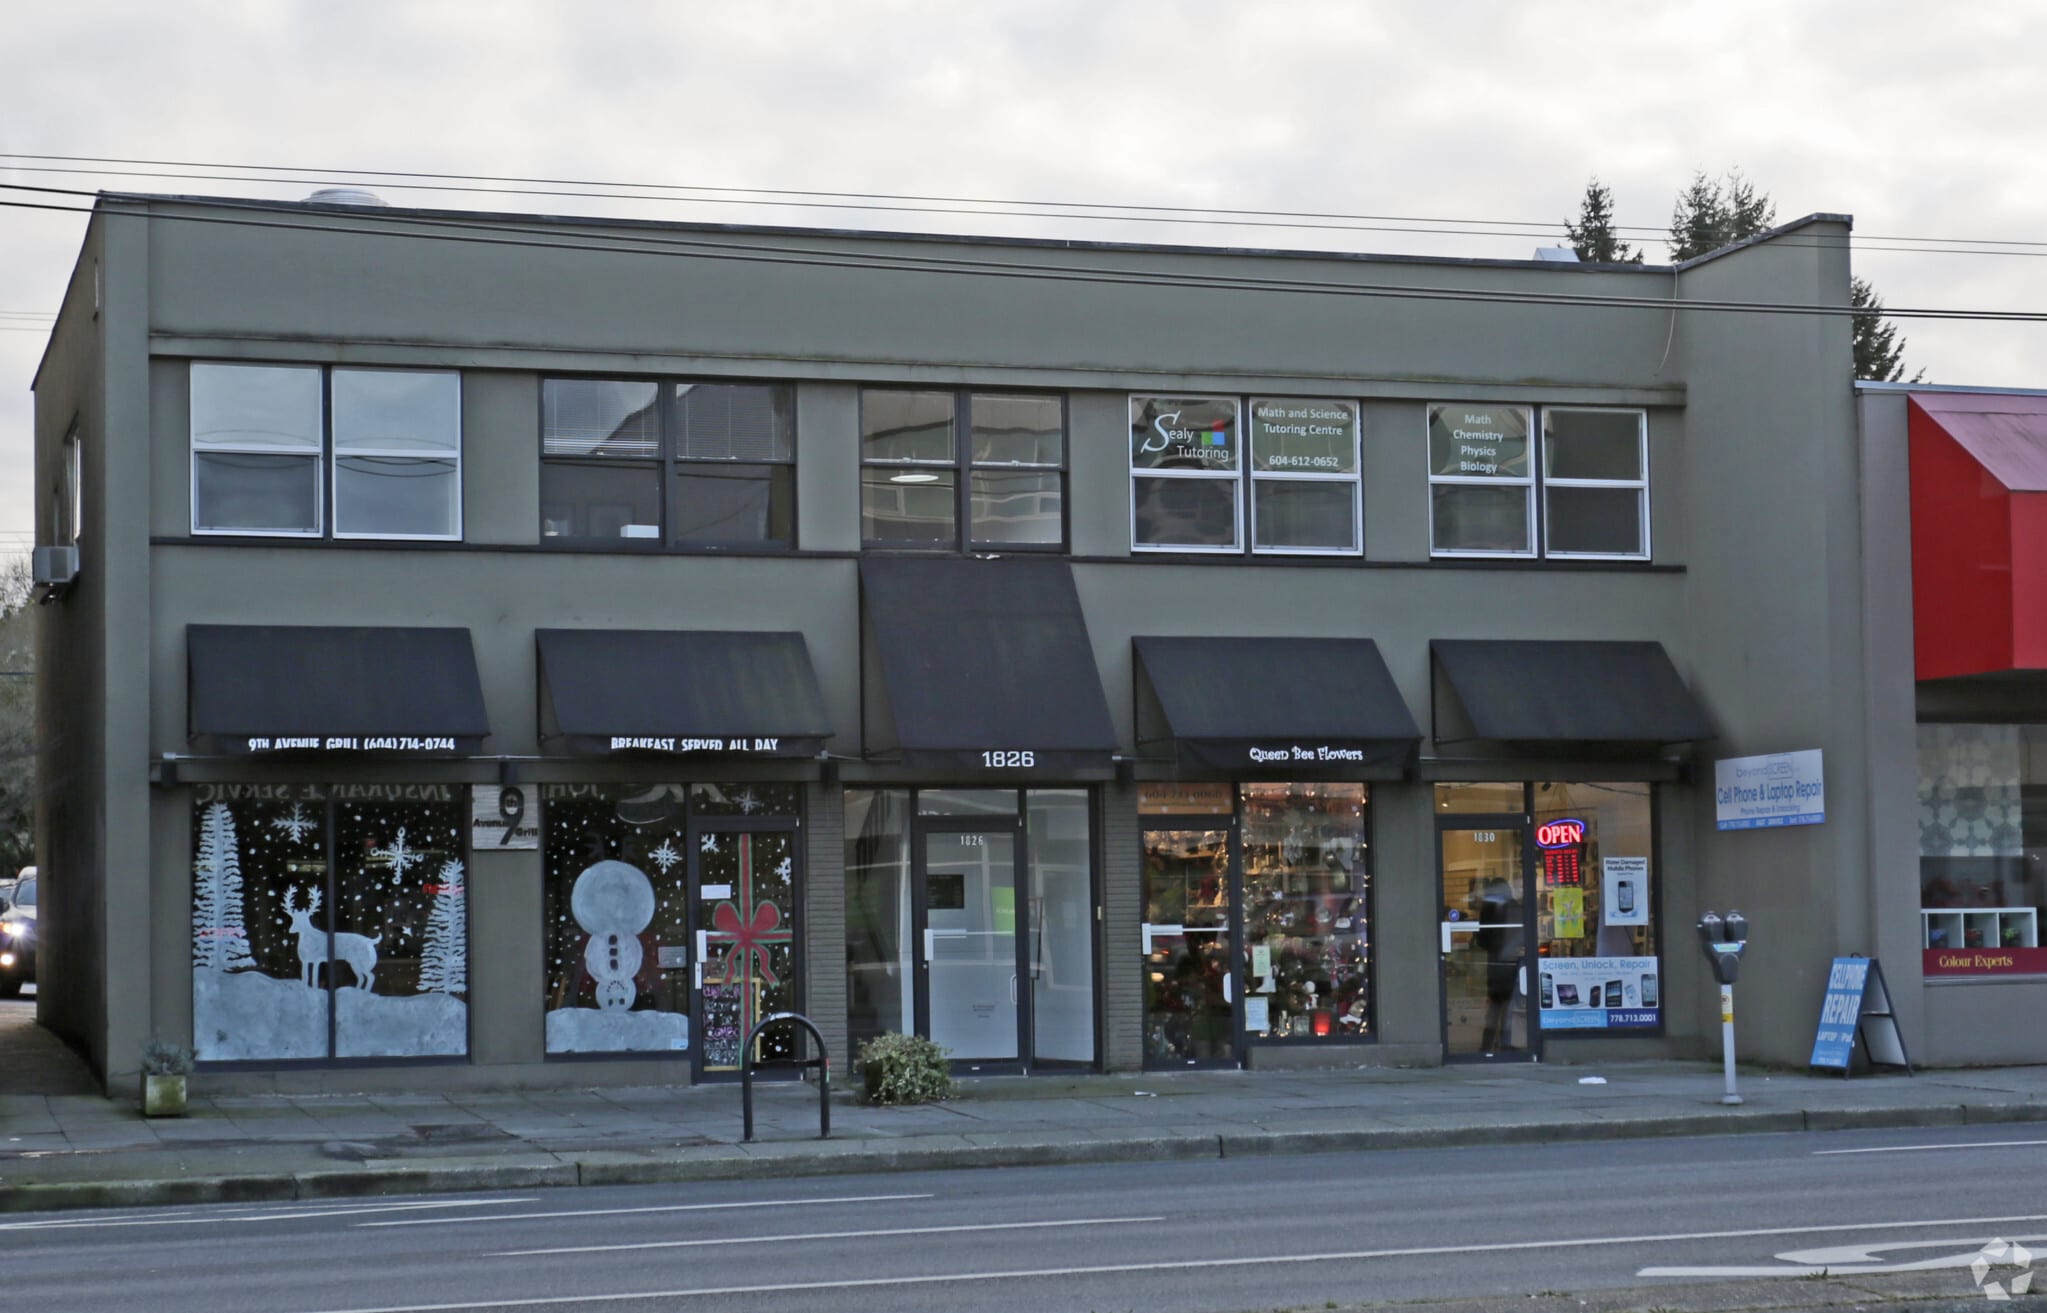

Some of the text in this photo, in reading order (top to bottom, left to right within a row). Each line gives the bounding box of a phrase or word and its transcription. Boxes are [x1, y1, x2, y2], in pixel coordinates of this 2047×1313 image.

[1258, 406, 1348, 420] Math and Science
[1464, 414, 1491, 425] Math
[1140, 410, 1194, 453] Sealy
[1263, 423, 1343, 436] Tutoring Centre
[1453, 429, 1503, 443] Chemistry
[1176, 445, 1229, 463] Tutoring
[1461, 445, 1496, 459] Physics
[1269, 454, 1339, 468] 604-612-0652
[1460, 461, 1497, 475] Biology
[248, 737, 270, 752] 9TH
[274, 737, 320, 751] AVENUE
[611, 736, 675, 751] BREAKFAST
[682, 738, 723, 752] SERVED
[755, 738, 778, 751] DAY
[982, 751, 1035, 768] 1826
[1250, 745, 1364, 762] Queen Bee Flowers
[1718, 778, 1822, 805] Cell Phone & Laptop Repair
[499, 787, 525, 845] 9
[960, 834, 984, 847] 1826
[1473, 831, 1496, 843] 1830
[1538, 824, 1582, 845] OPEN
[1543, 960, 1578, 970] Screen,
[1620, 959, 1650, 970] Repair
[1939, 955, 2013, 969] Colour Experts
[1821, 994, 1862, 1025] REPAIR
